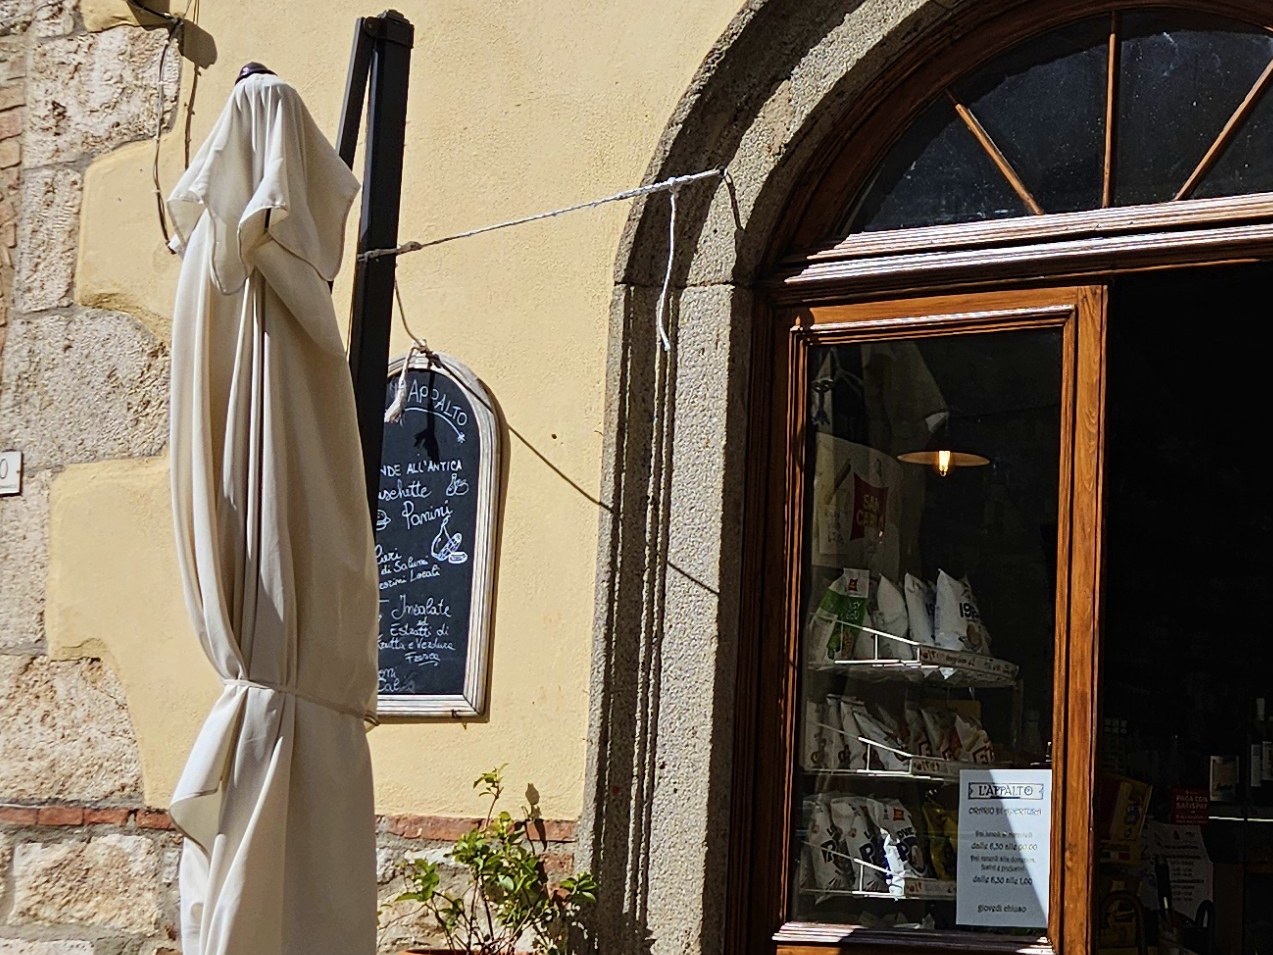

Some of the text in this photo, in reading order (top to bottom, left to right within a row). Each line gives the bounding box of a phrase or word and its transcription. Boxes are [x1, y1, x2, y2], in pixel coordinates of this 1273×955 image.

[401, 500, 454, 530] Panini
[391, 594, 452, 620] Insalate
[979, 785, 1033, 796] L'APPALTO
